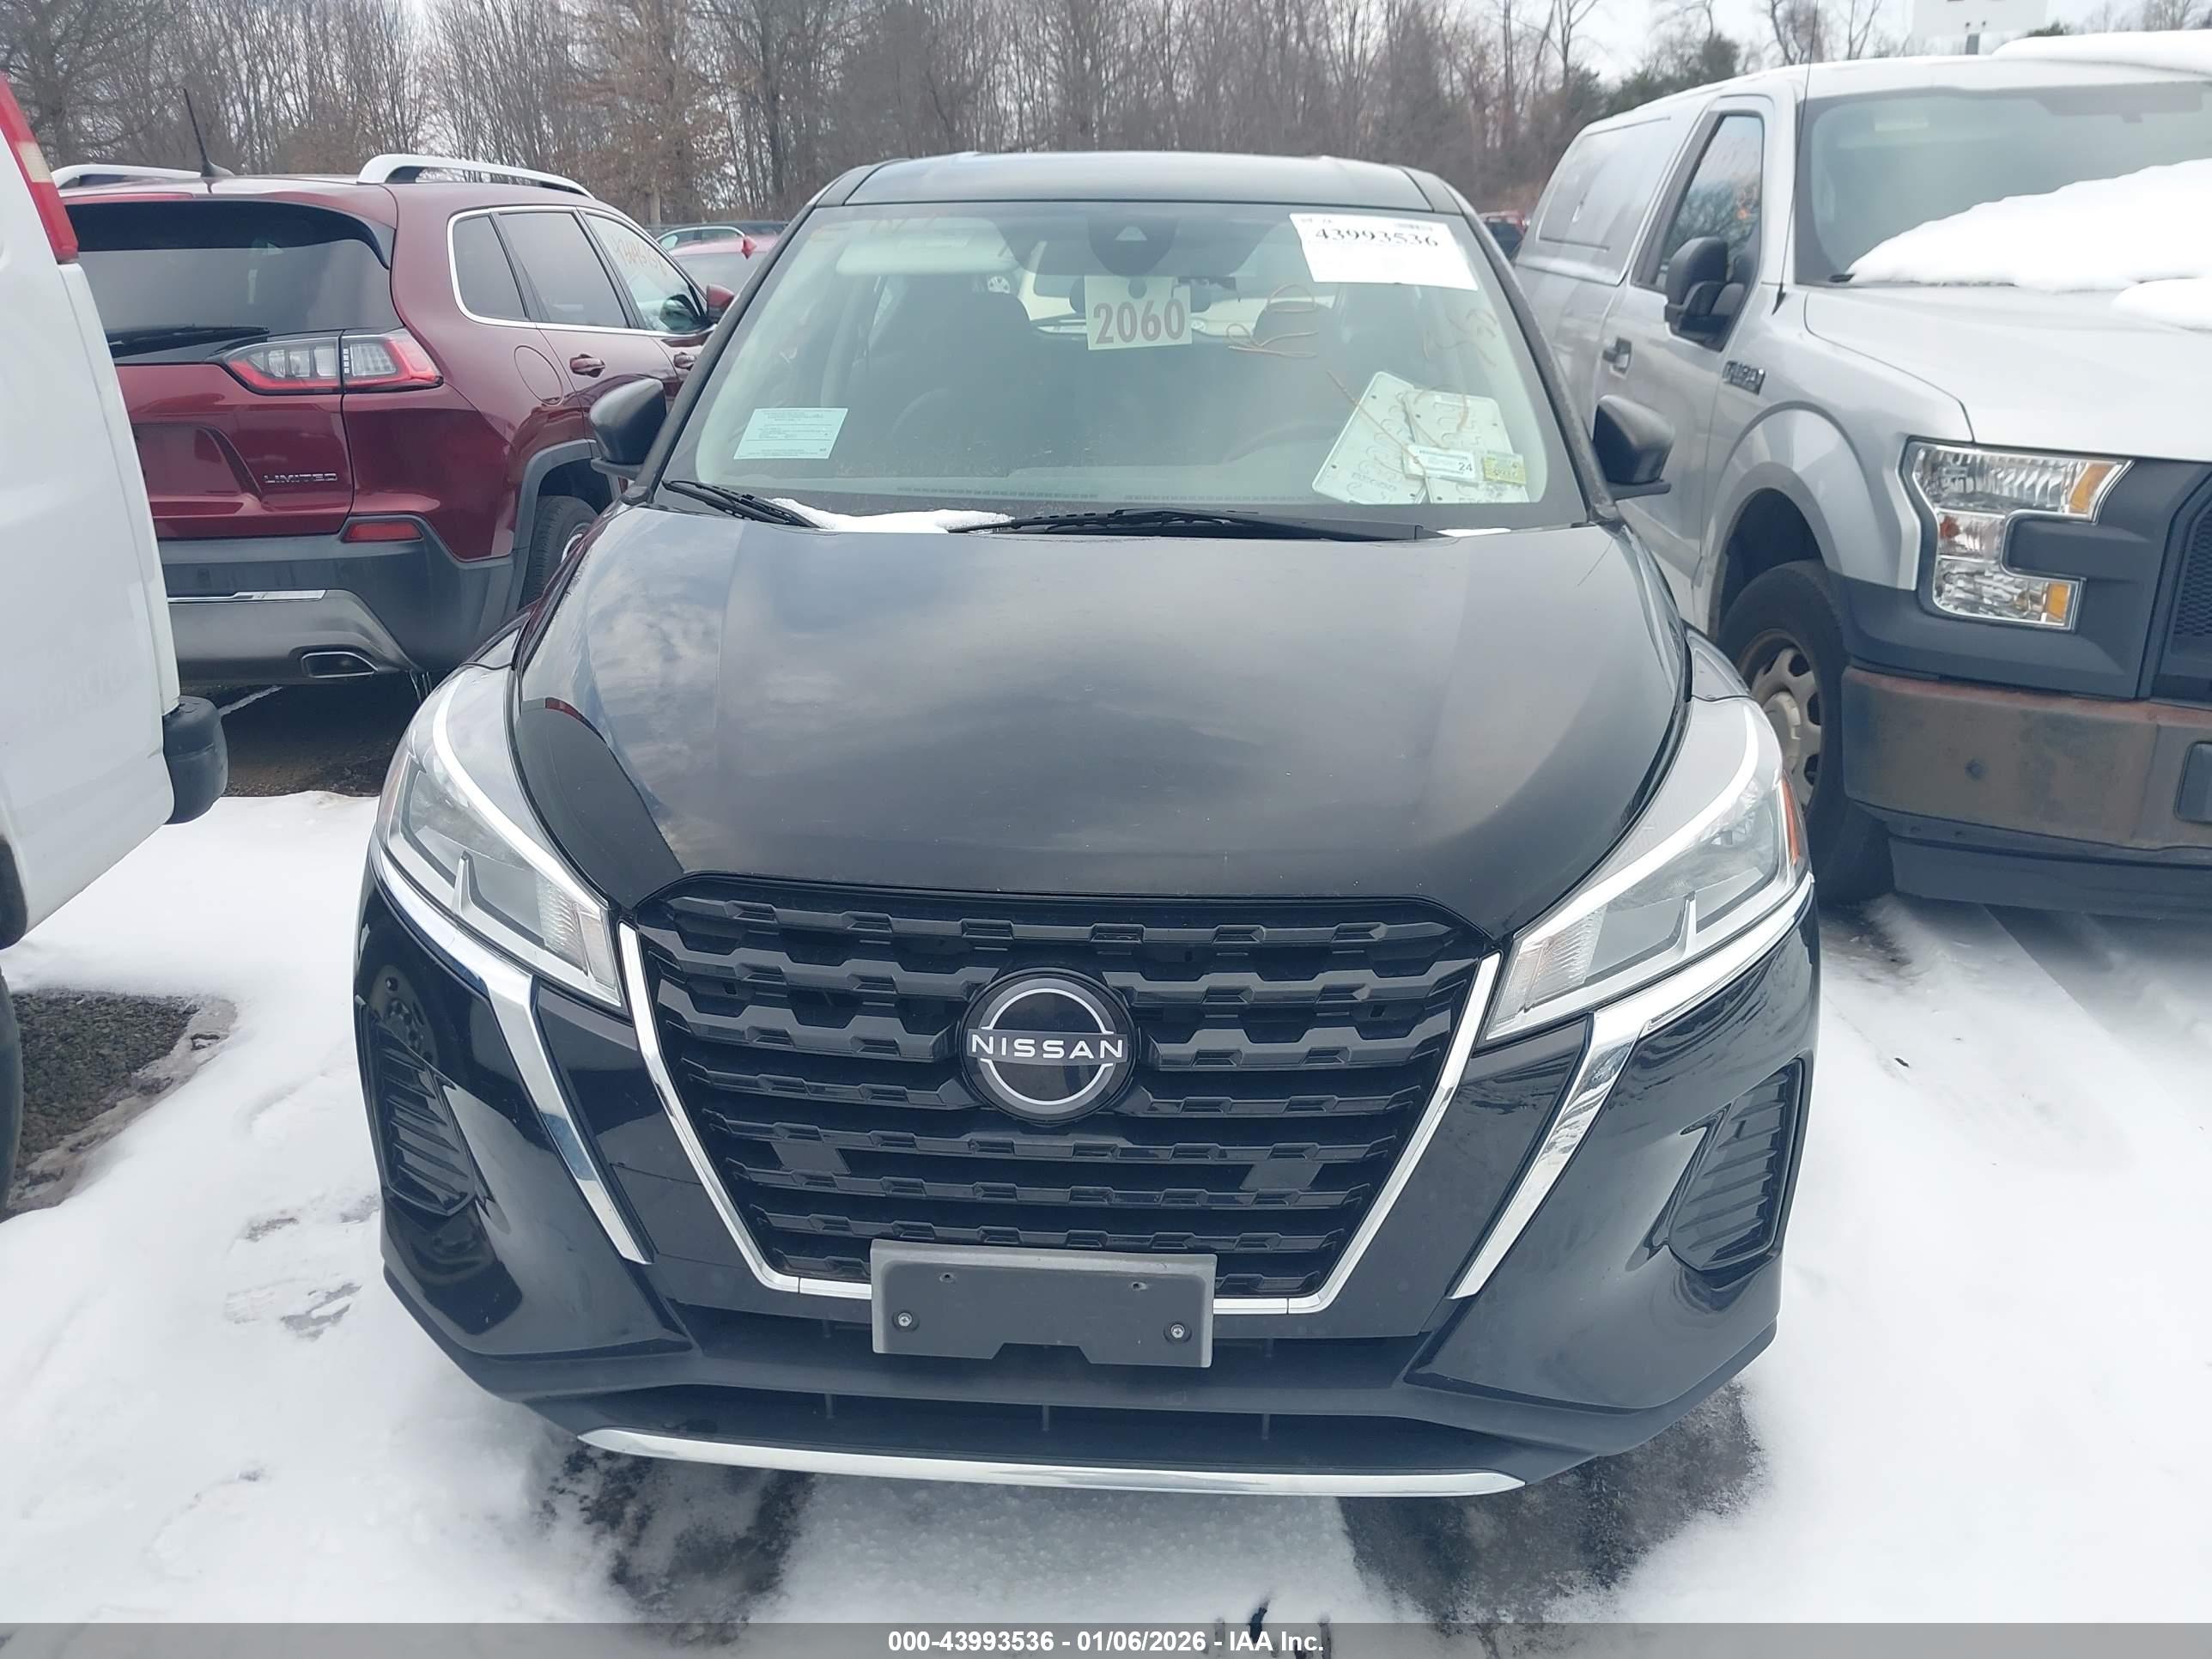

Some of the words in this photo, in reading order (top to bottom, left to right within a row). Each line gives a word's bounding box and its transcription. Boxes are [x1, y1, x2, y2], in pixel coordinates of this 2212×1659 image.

[1315, 228, 1439, 247] 43993536
[1093, 298, 1186, 344] 2060
[1458, 461, 1474, 472] 24
[262, 472, 337, 483] LIMITED
[971, 1033, 1123, 1060] NISSAN
